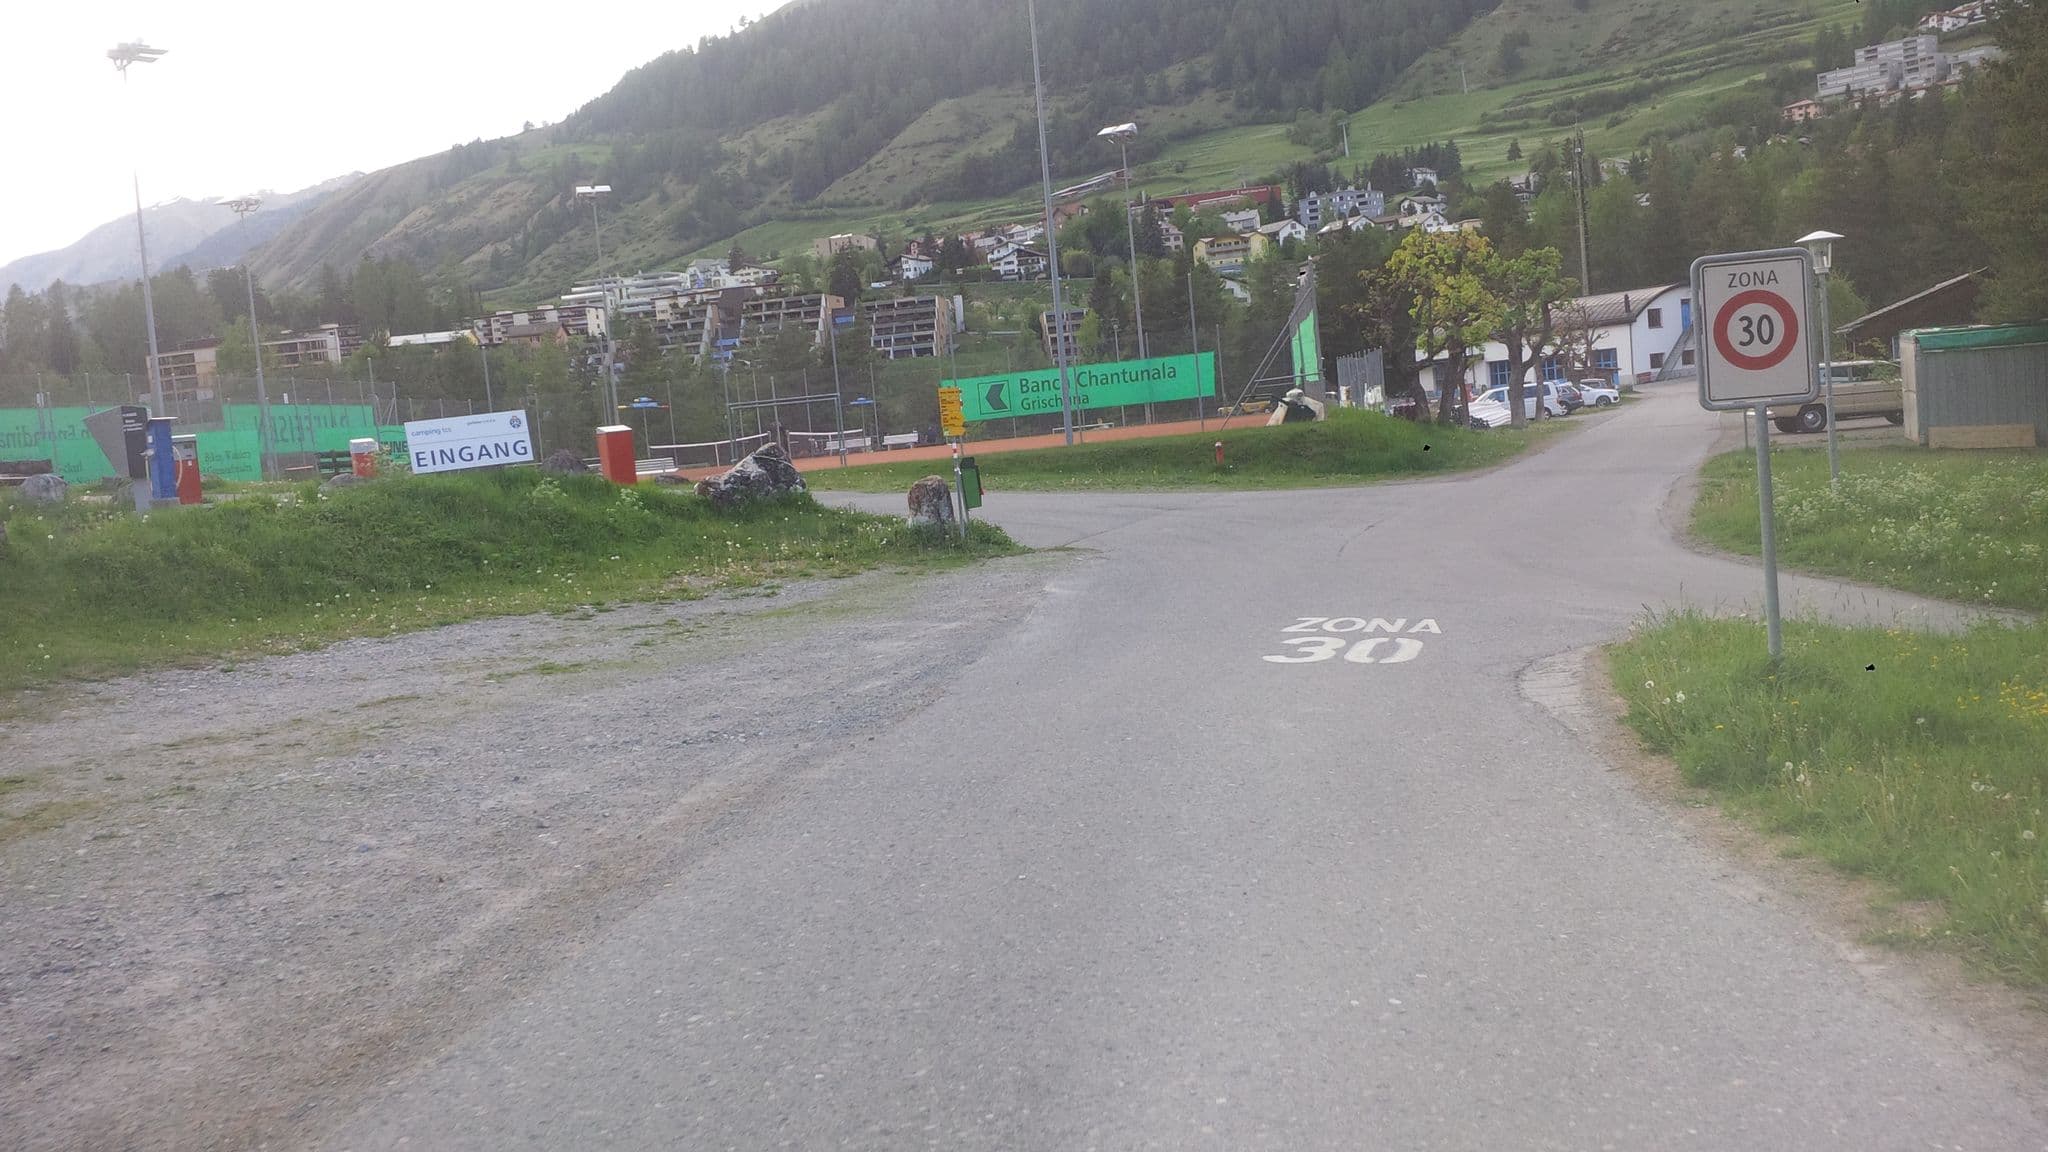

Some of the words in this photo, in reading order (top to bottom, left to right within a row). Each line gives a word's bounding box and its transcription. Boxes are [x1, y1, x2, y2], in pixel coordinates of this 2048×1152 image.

[1727, 270, 1779, 288] ZONA
[1738, 314, 1774, 347] 30
[1077, 363, 1177, 388] Chantunala
[1021, 394, 1089, 411] Grischna
[411, 427, 441, 437] camping
[415, 439, 528, 467] EINGANG
[1280, 617, 1442, 634] ZONA
[1262, 636, 1424, 664] 30
